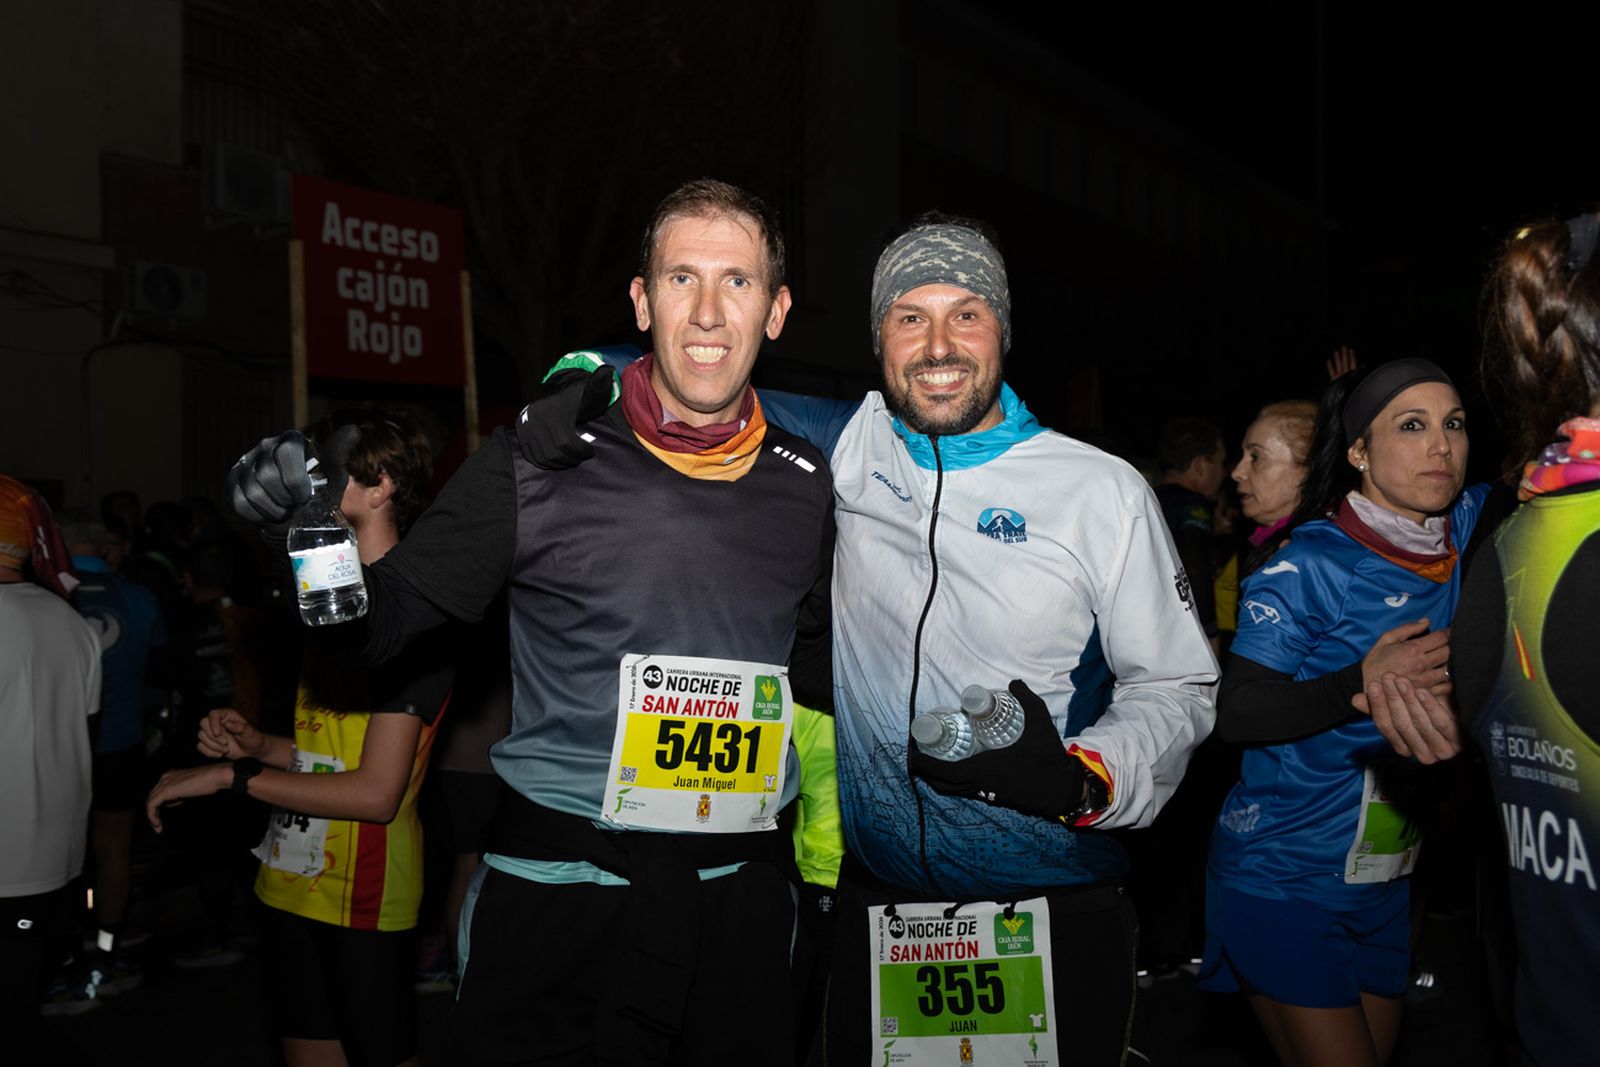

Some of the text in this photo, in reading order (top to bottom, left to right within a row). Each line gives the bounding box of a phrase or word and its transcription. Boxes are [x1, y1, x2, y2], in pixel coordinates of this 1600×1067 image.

[321, 200, 440, 264] Acceso
[337, 259, 430, 313] cajón
[347, 308, 423, 365] Rojo
[643, 670, 662, 683] 43
[666, 668, 688, 676] CARRERA
[666, 675, 742, 697] NOCHE DE
[642, 695, 740, 719] SAN ANTÓN
[655, 719, 762, 773] 5431
[1507, 736, 1577, 771] BOLAÑOS
[673, 775, 737, 792] Juan Miguel
[890, 920, 904, 935] 43
[907, 920, 978, 939] NOCHE DE
[890, 937, 978, 962] SAN ANTÓN
[916, 963, 1005, 1017] 355
[949, 1020, 978, 1033] JUAN
